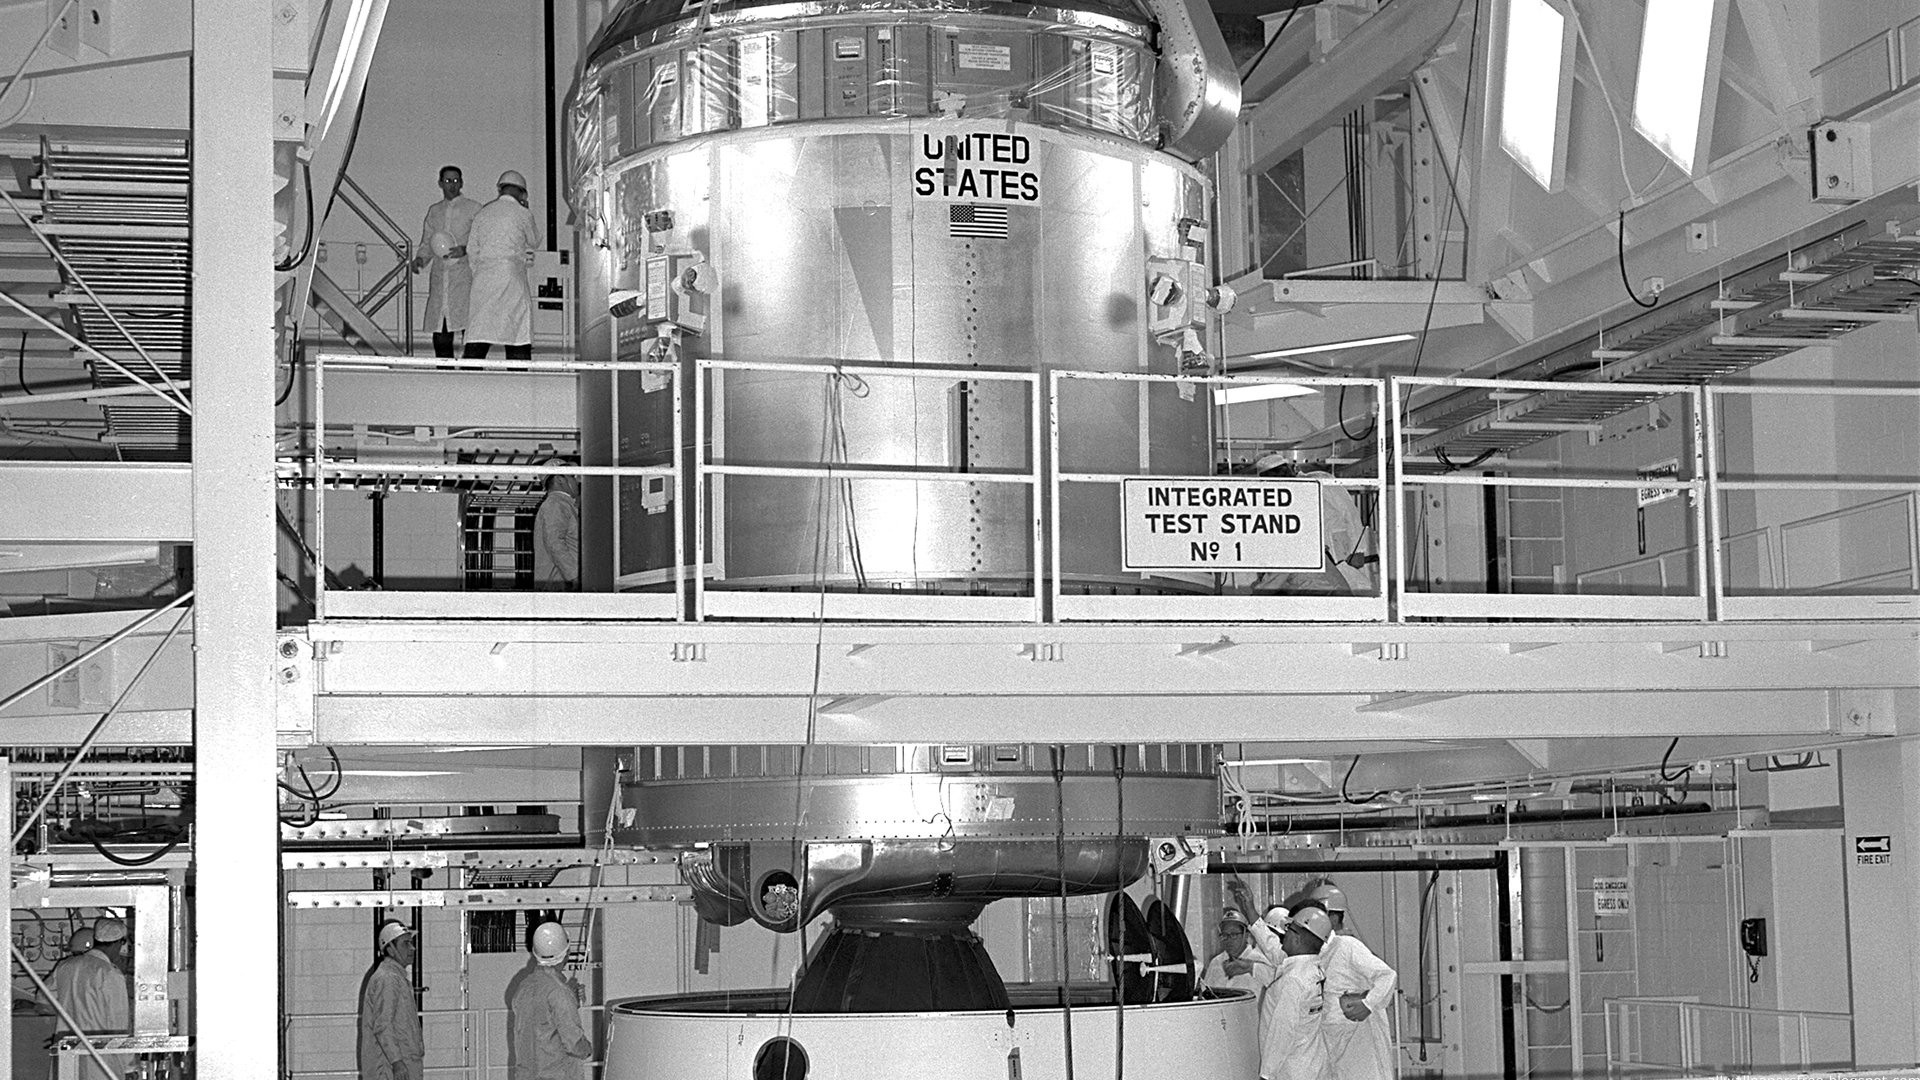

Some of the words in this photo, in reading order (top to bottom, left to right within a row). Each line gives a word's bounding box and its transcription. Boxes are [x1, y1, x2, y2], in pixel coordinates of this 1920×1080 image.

[1148, 487, 1293, 507] INTEGRATED
[1145, 514, 1208, 533] TEST
[1221, 513, 1301, 534] STAND
[1235, 541, 1242, 561] 1
[1857, 854, 1873, 864] FIRE
[1875, 854, 1890, 864] EXIT
[1598, 898, 1616, 909] EGRESS
